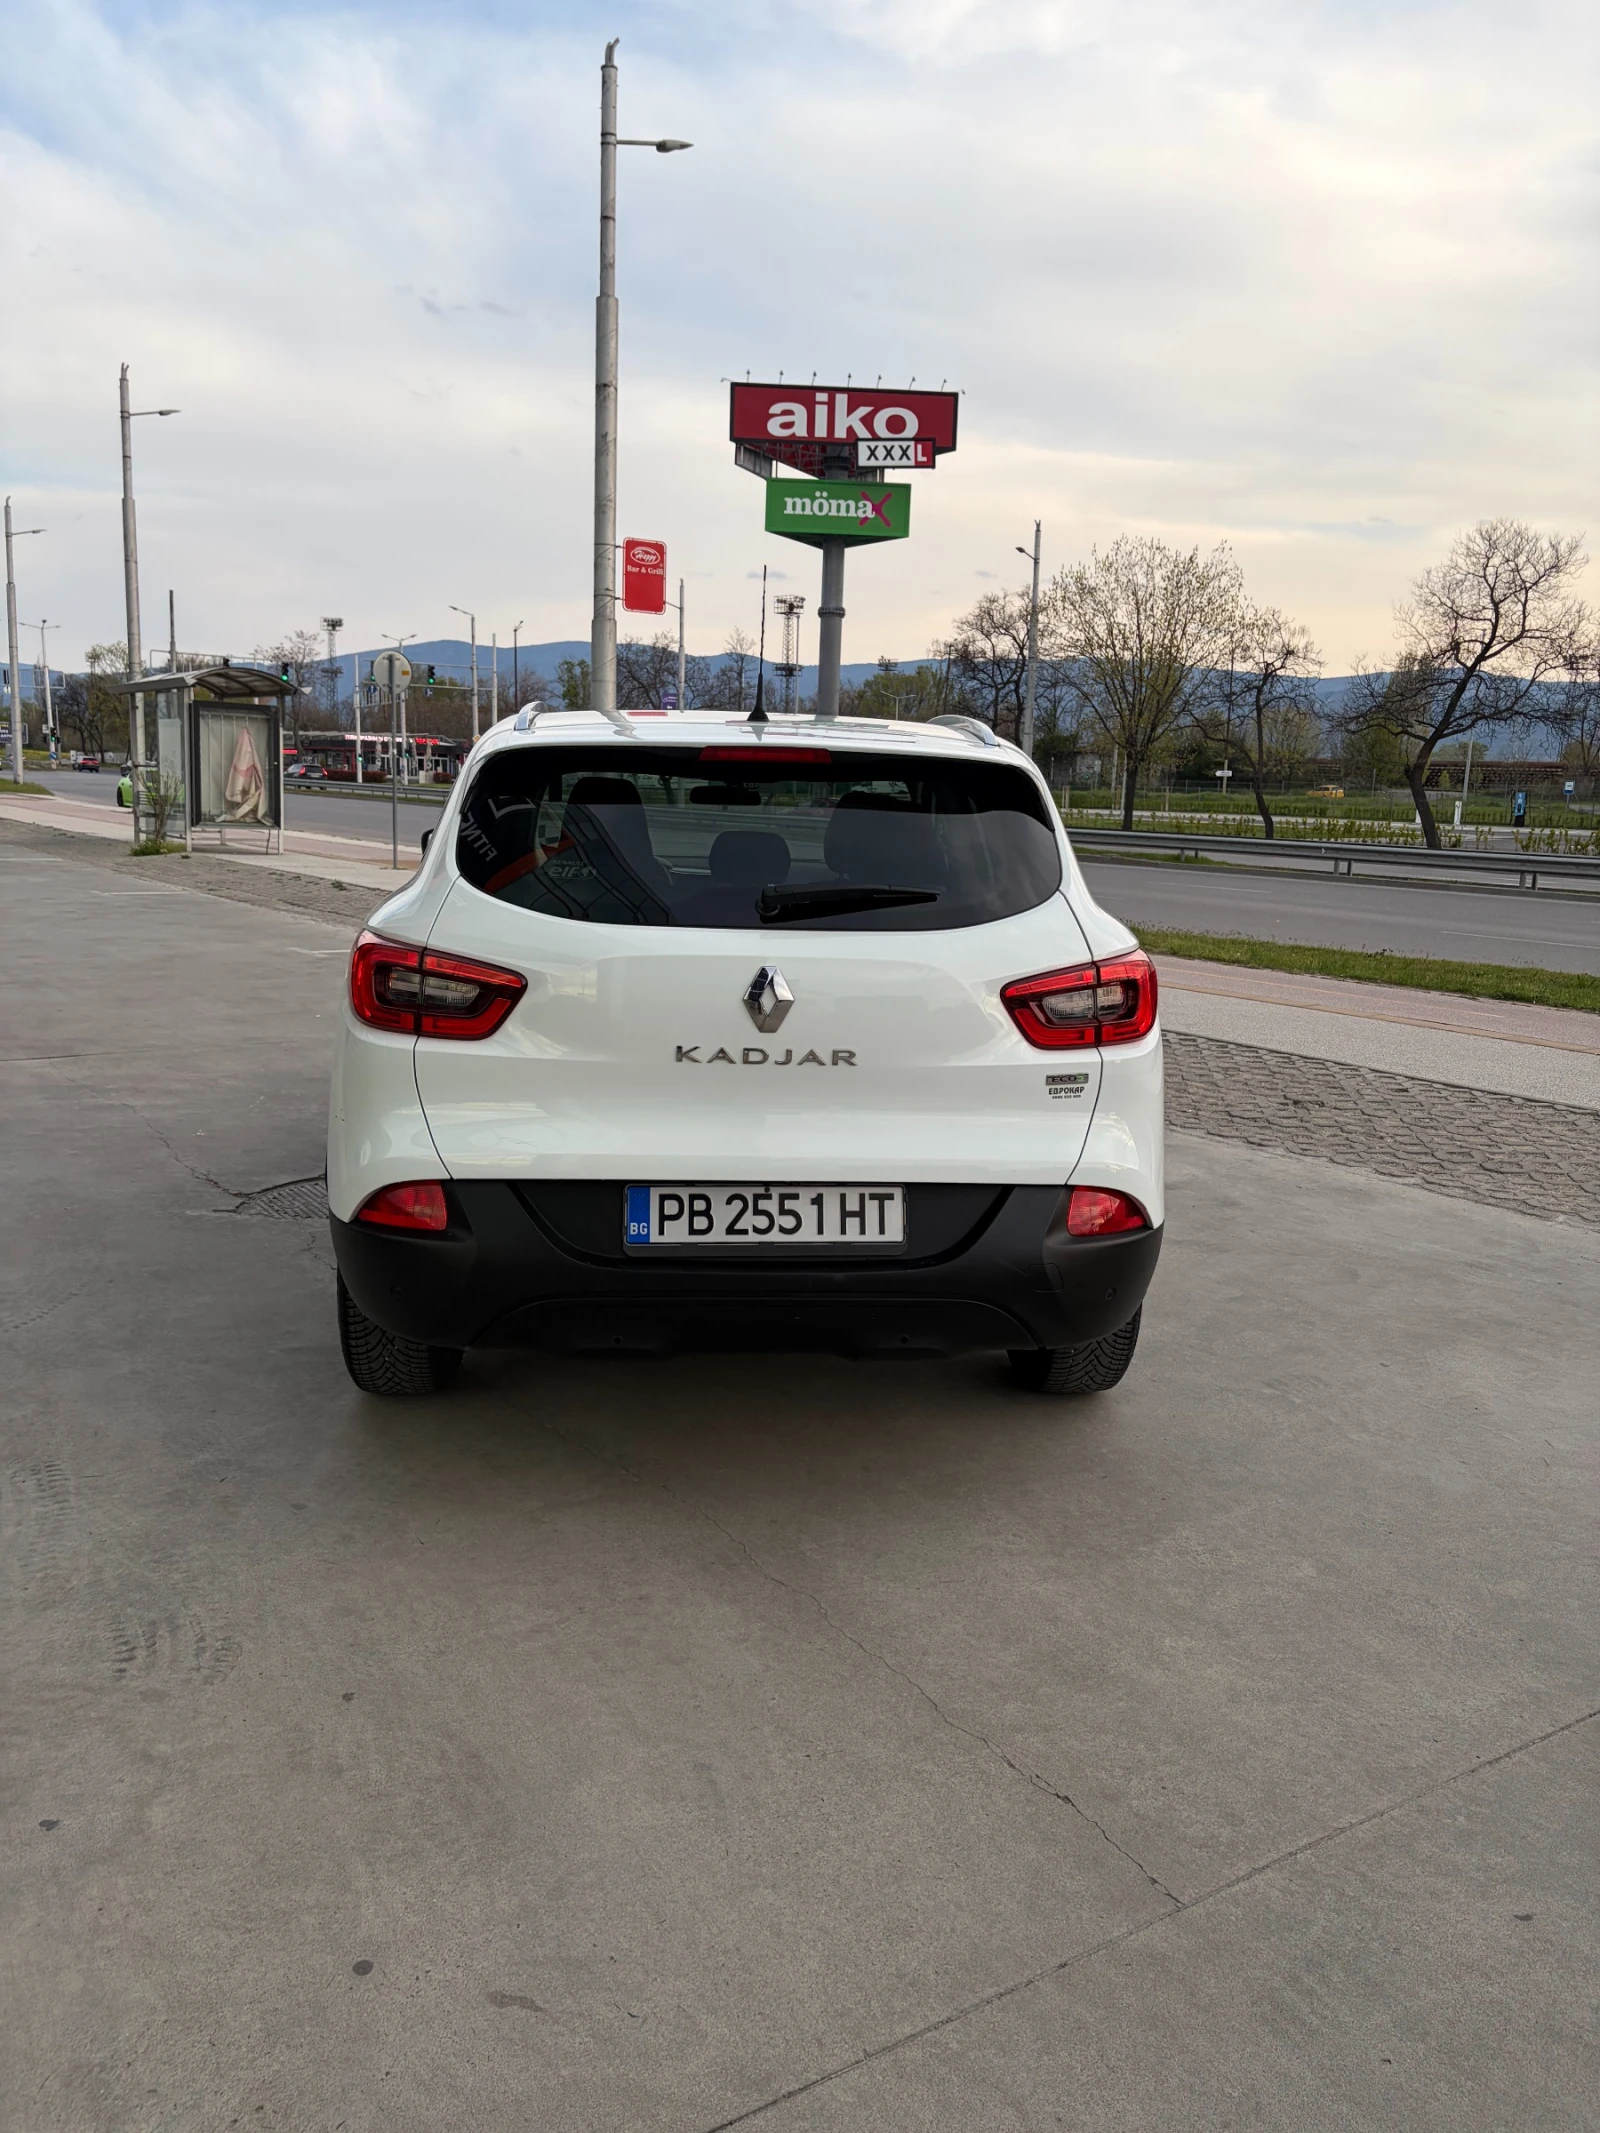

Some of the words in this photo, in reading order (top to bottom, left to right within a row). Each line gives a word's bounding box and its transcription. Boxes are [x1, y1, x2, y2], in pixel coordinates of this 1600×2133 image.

[766, 392, 919, 439] aiko
[866, 444, 927, 462] XXXL
[627, 565, 639, 573] Bar
[640, 566, 647, 574] &
[648, 567, 664, 576] Grill
[675, 1045, 858, 1066] KADJAR
[1048, 1086, 1085, 1095] ЕВРОКАР
[629, 1222, 648, 1235] BG
